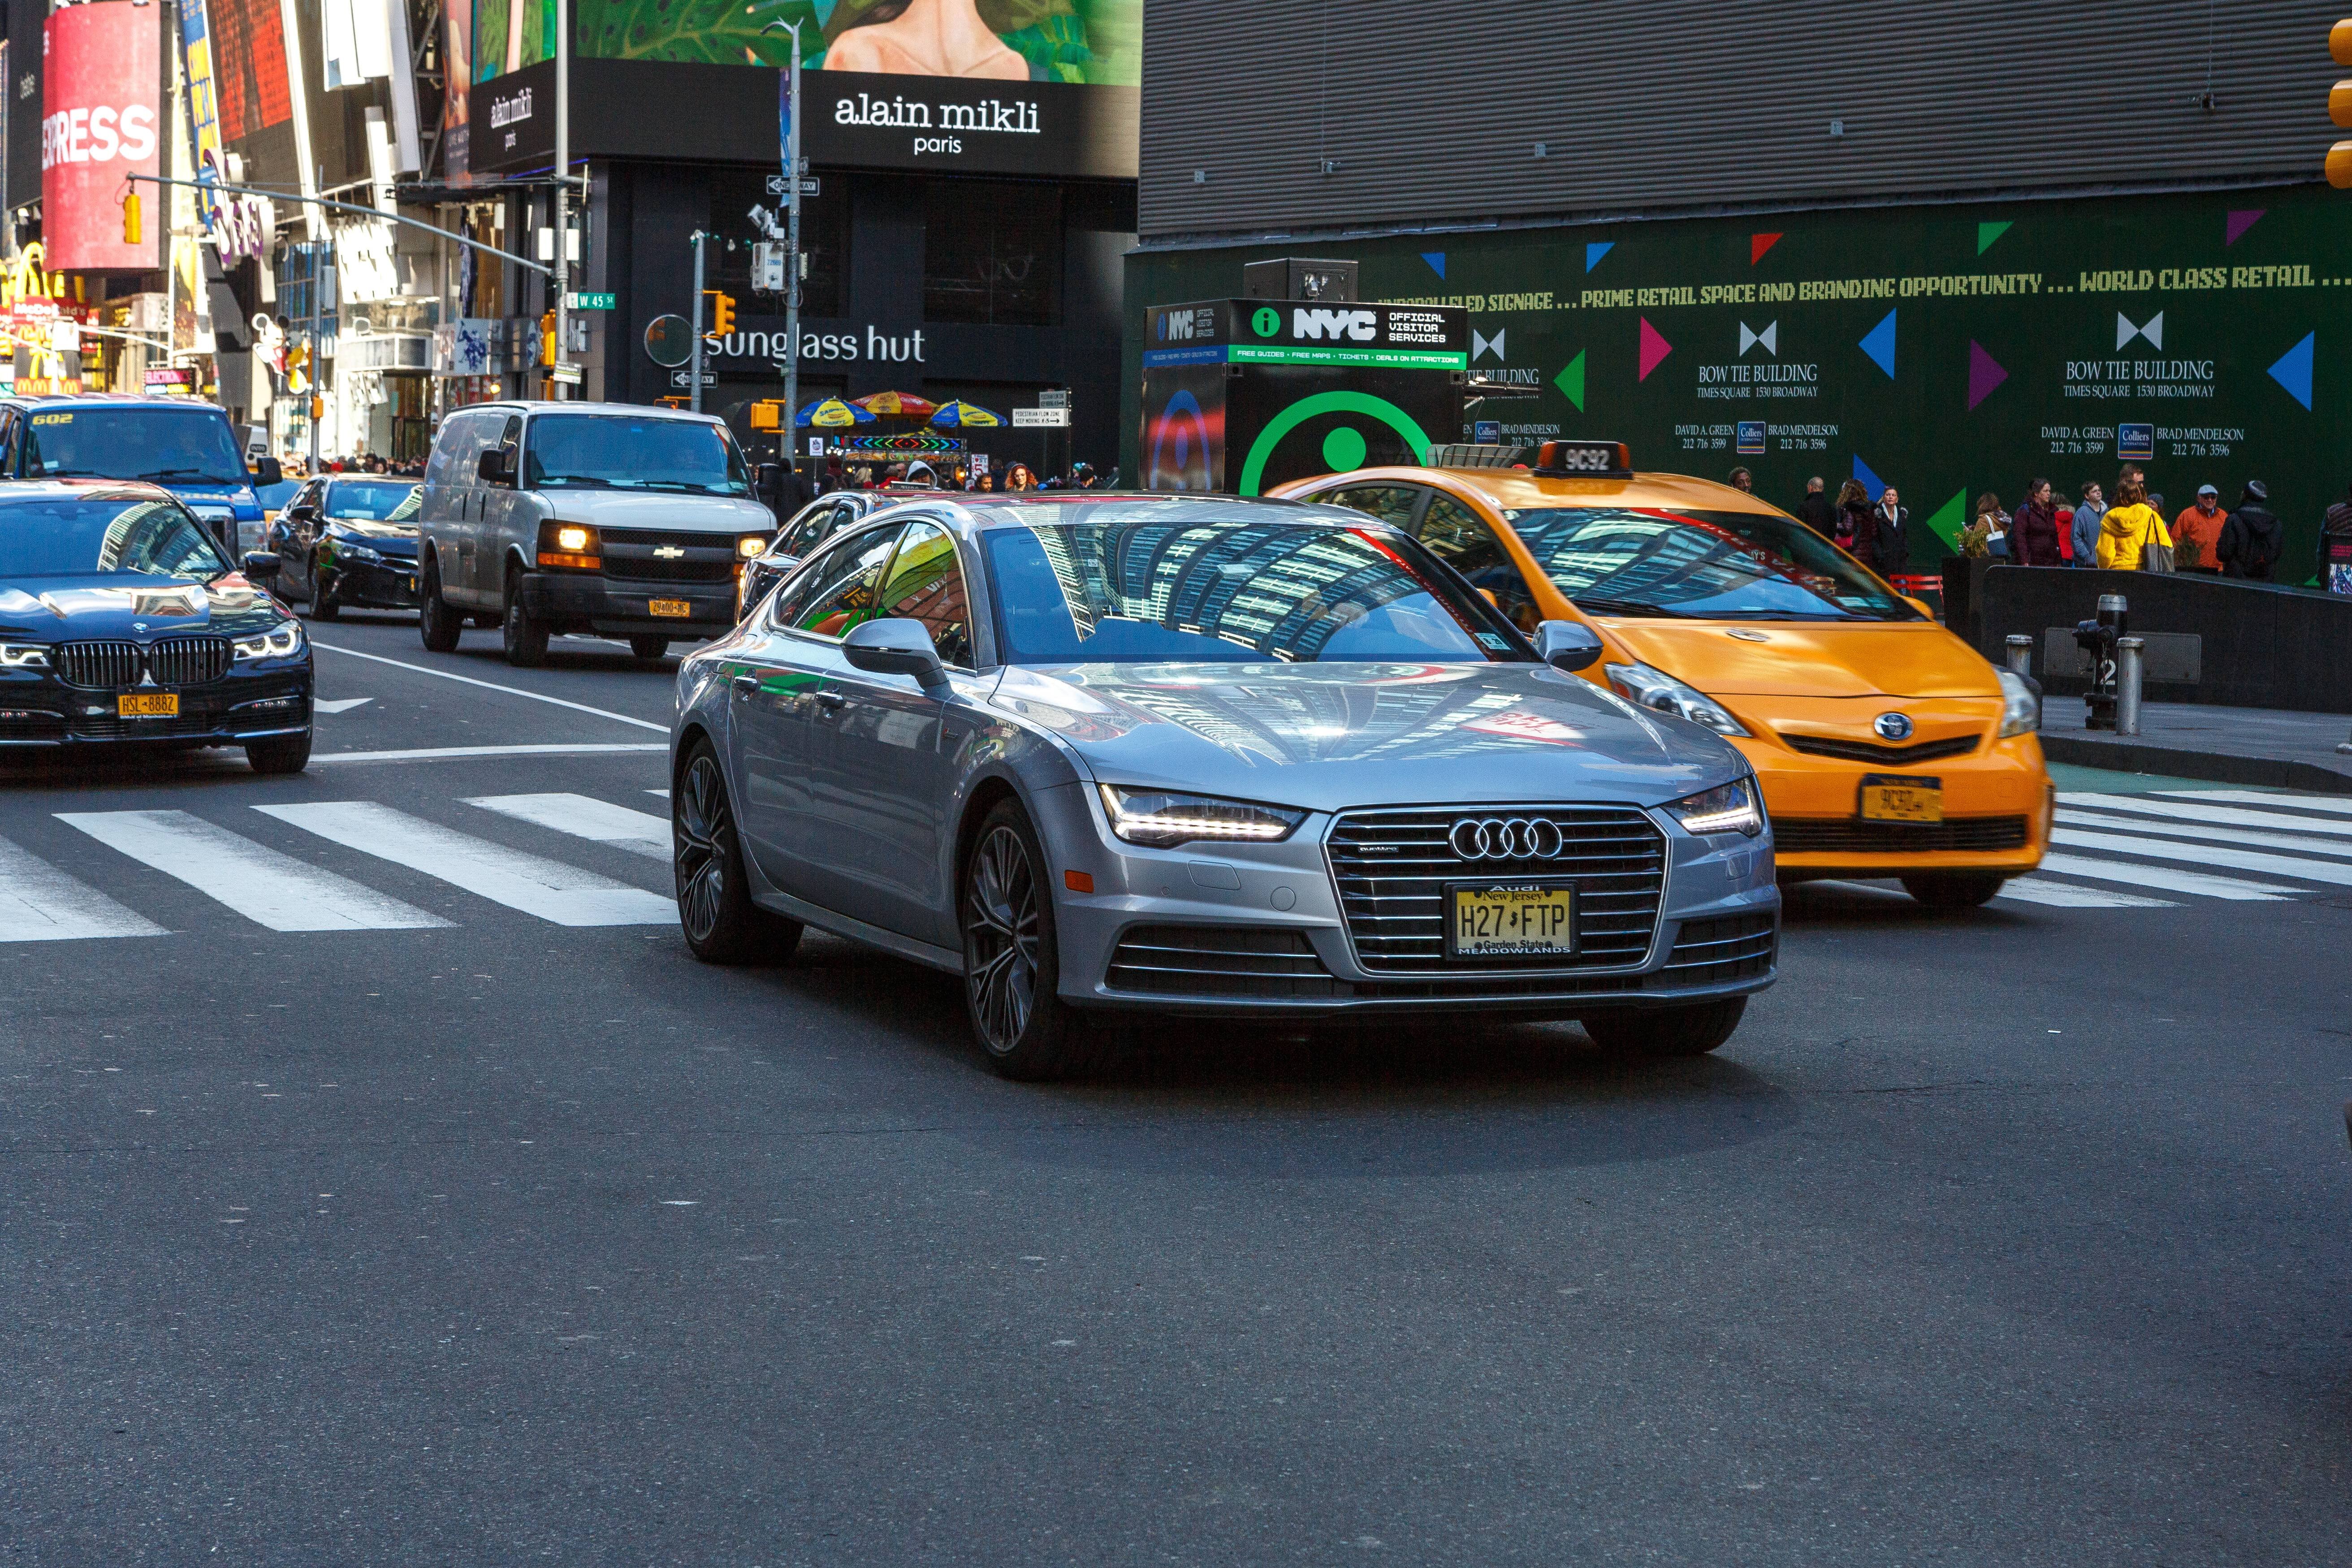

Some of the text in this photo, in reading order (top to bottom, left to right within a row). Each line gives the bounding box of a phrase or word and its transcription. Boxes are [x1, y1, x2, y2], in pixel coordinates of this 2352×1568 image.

[835, 93, 1041, 133] alain mikli
[914, 136, 962, 155] paris
[1488, 292, 1553, 311] SIGNAGE
[1582, 289, 1634, 308] PRIME
[1637, 287, 1696, 306] RETAIL
[1700, 284, 1756, 304] SPACE
[1759, 282, 1795, 302] AND
[1799, 278, 1895, 301] BRANDING
[1899, 274, 2042, 297] OPPORTUNITY
[2080, 270, 2153, 292] WORLD
[2159, 268, 2227, 290] CLASS
[2232, 265, 2315, 288] RETAIL
[579, 295, 588, 307] W
[592, 296, 603, 307] 45
[1389, 312, 1445, 323] OFFICIAL
[1169, 310, 1194, 340] NYC
[1293, 308, 1376, 341] NYC
[1389, 323, 1438, 333] VISITOR
[1389, 333, 1446, 343] SERVICES
[705, 323, 925, 367] sunglass hut
[1699, 364, 1817, 382] BOW TIE BUILDING
[2067, 360, 2213, 380] BOW TIE BUILDING
[1485, 369, 1539, 384] BUILDING
[1697, 386, 1818, 399] TIMES SQUARE 1530 BROADWAY
[2064, 385, 2214, 399] TIMES SQUARE 1530 BROADWAY
[32, 413, 74, 425] 602
[1478, 427, 1497, 436] Colliers
[1501, 424, 1560, 434] BRAD MENDELSON
[1675, 425, 1734, 435] DAVID A. GREEN
[1741, 427, 1762, 437] Colliers
[1768, 425, 1838, 436] BRAD MENDELSON
[2042, 427, 2114, 439] DAVID A. GREEN
[2157, 428, 2244, 441] BRAD MENDELSON
[2123, 430, 2149, 441] Colliers
[1512, 438, 1522, 446] 212
[1525, 438, 1534, 446] 716
[1683, 439, 1725, 449] 212 716 3599
[1781, 439, 1826, 449] 212 716 3596
[2051, 442, 2104, 453] 212 716 3599
[2172, 444, 2229, 456] 212 716 3596
[2100, 659, 2116, 685] 2
[122, 697, 142, 712] HSL
[1483, 891, 1544, 903] New Jersey
[1461, 904, 1565, 937] H27 FTP
[1483, 939, 1544, 949] Garden State
